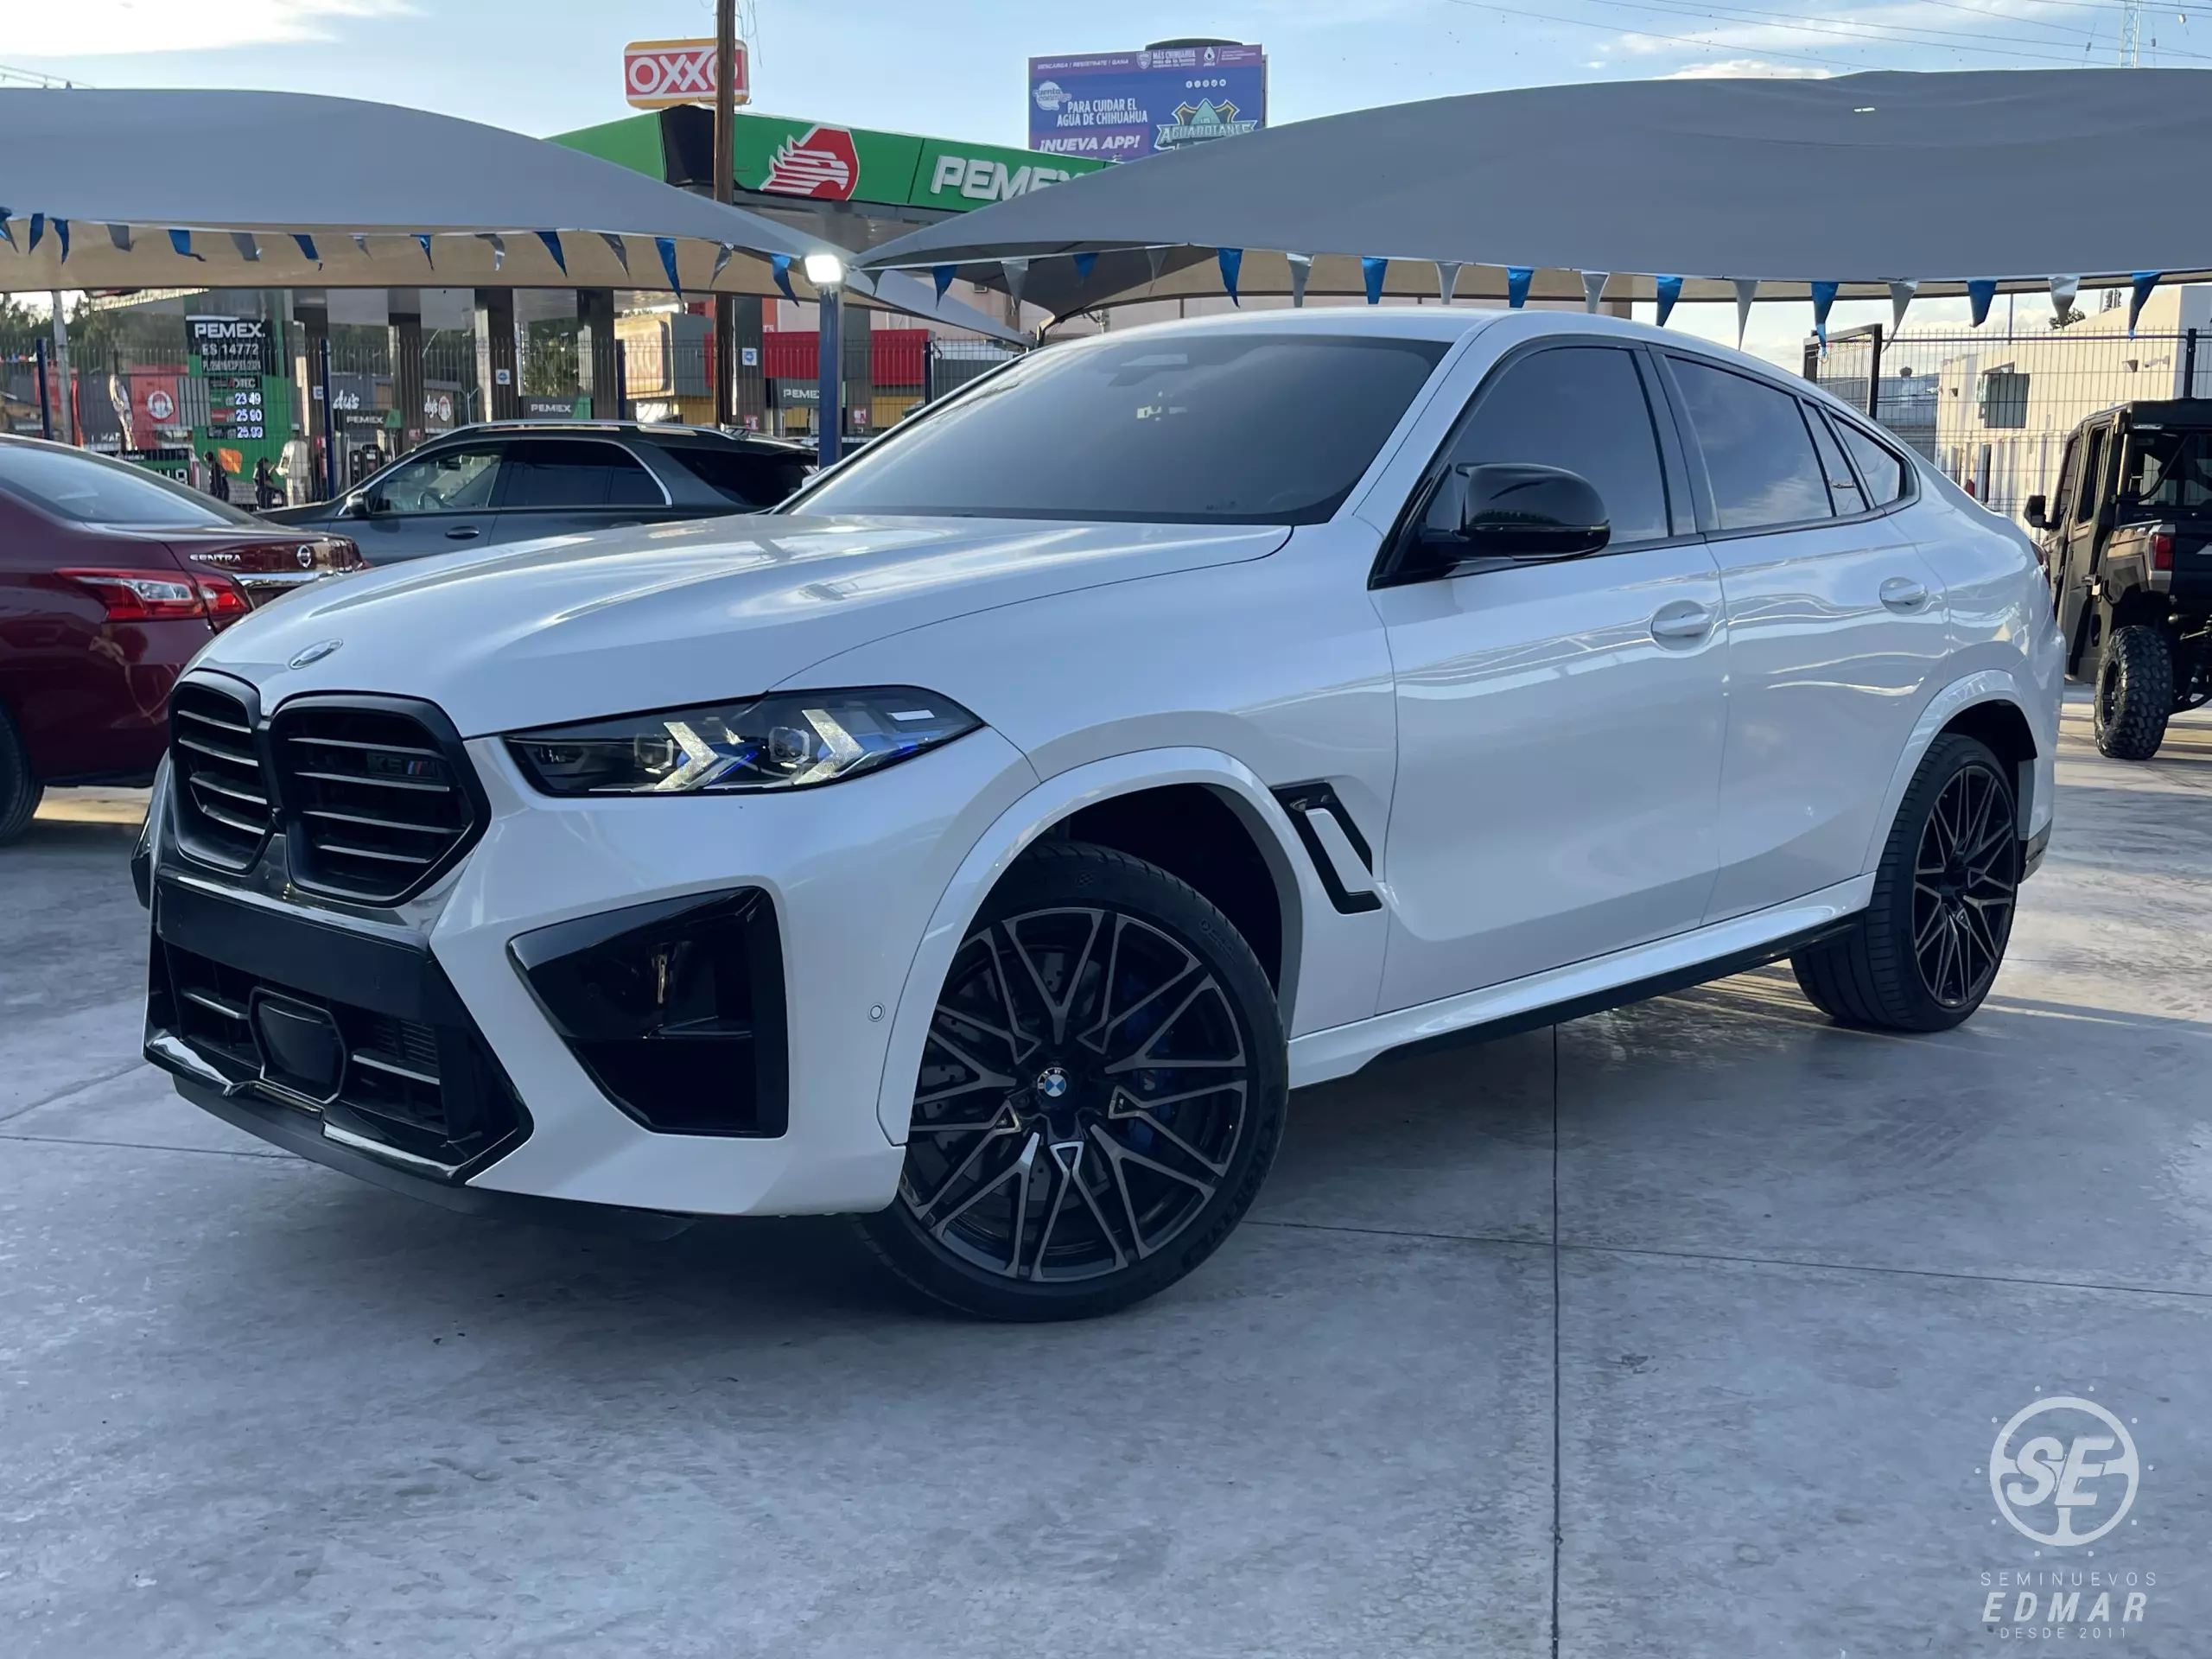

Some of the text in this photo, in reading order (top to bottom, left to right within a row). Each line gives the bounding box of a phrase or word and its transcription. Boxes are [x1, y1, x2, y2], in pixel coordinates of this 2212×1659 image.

[1067, 98, 1137, 113] PARA CUIDAR EL
[1057, 111, 1147, 127] AGUA DE CHIHUAHUA
[1101, 135, 1141, 149] APP!
[931, 156, 1085, 200] PEME
[221, 343, 259, 355] 14772
[783, 389, 819, 398] PEME
[531, 404, 571, 413] PEMEX
